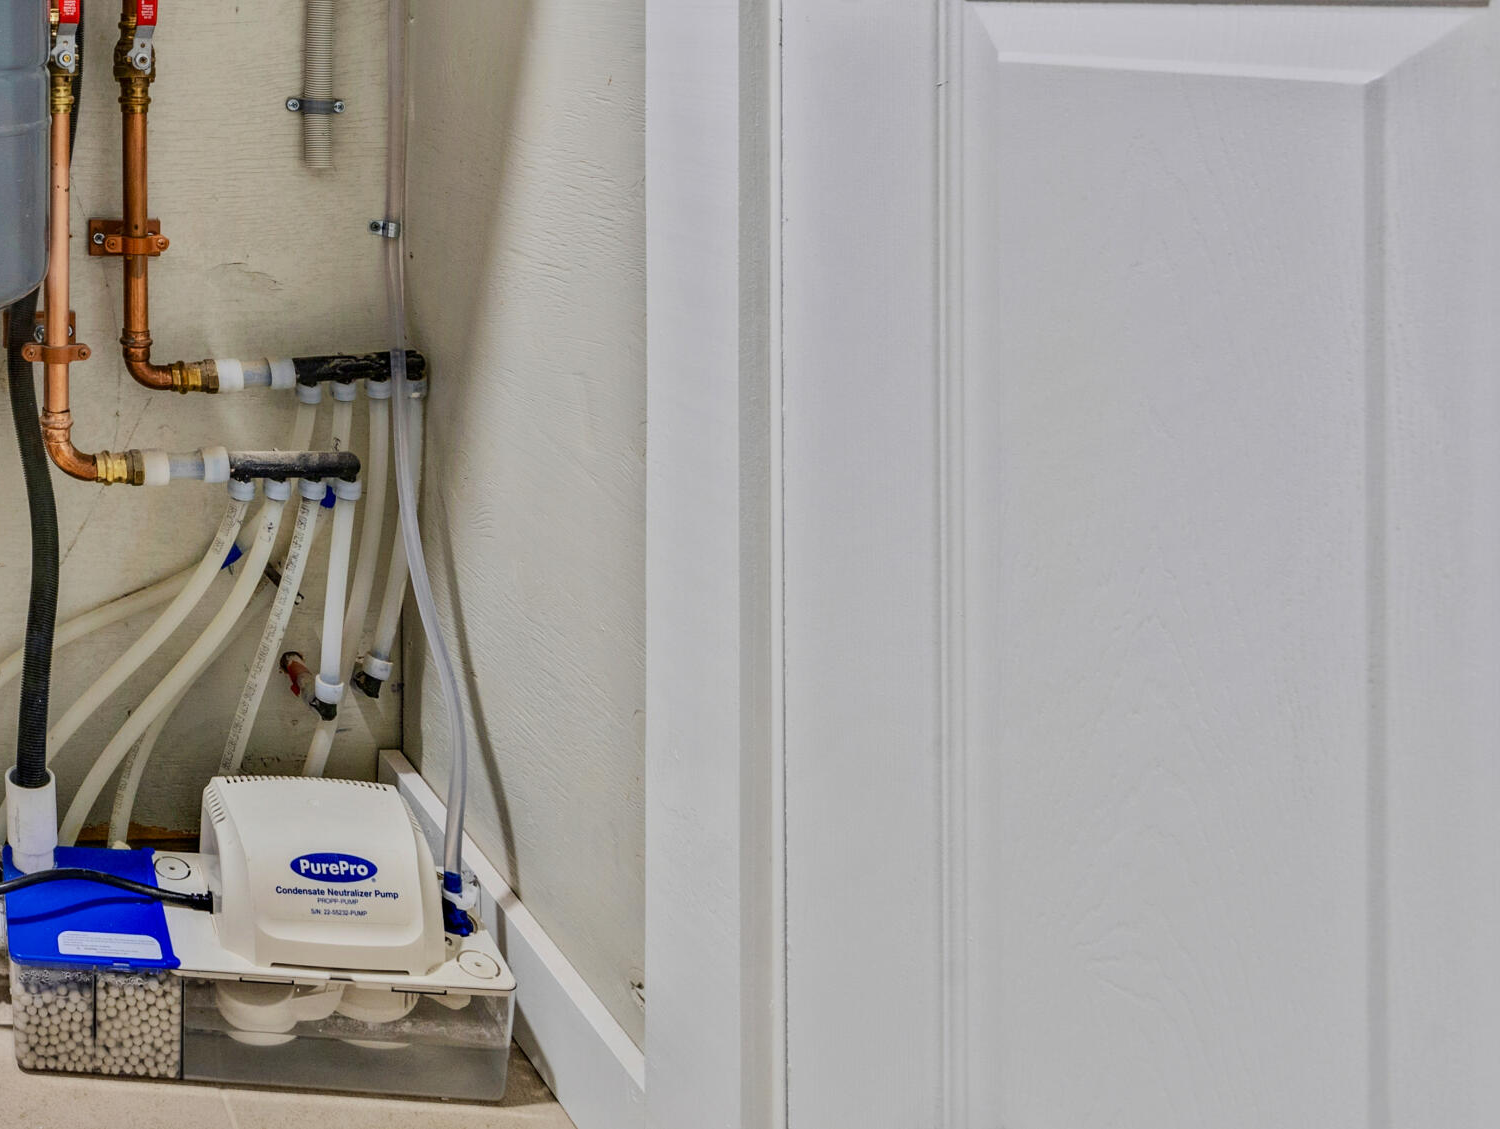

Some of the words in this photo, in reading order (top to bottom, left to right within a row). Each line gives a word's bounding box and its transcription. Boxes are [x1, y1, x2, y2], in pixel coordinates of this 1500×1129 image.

[299, 859, 369, 876] PurePro
[275, 885, 325, 896] Condensate
[328, 888, 372, 899] Neutralizer
[375, 889, 399, 900] Pump
